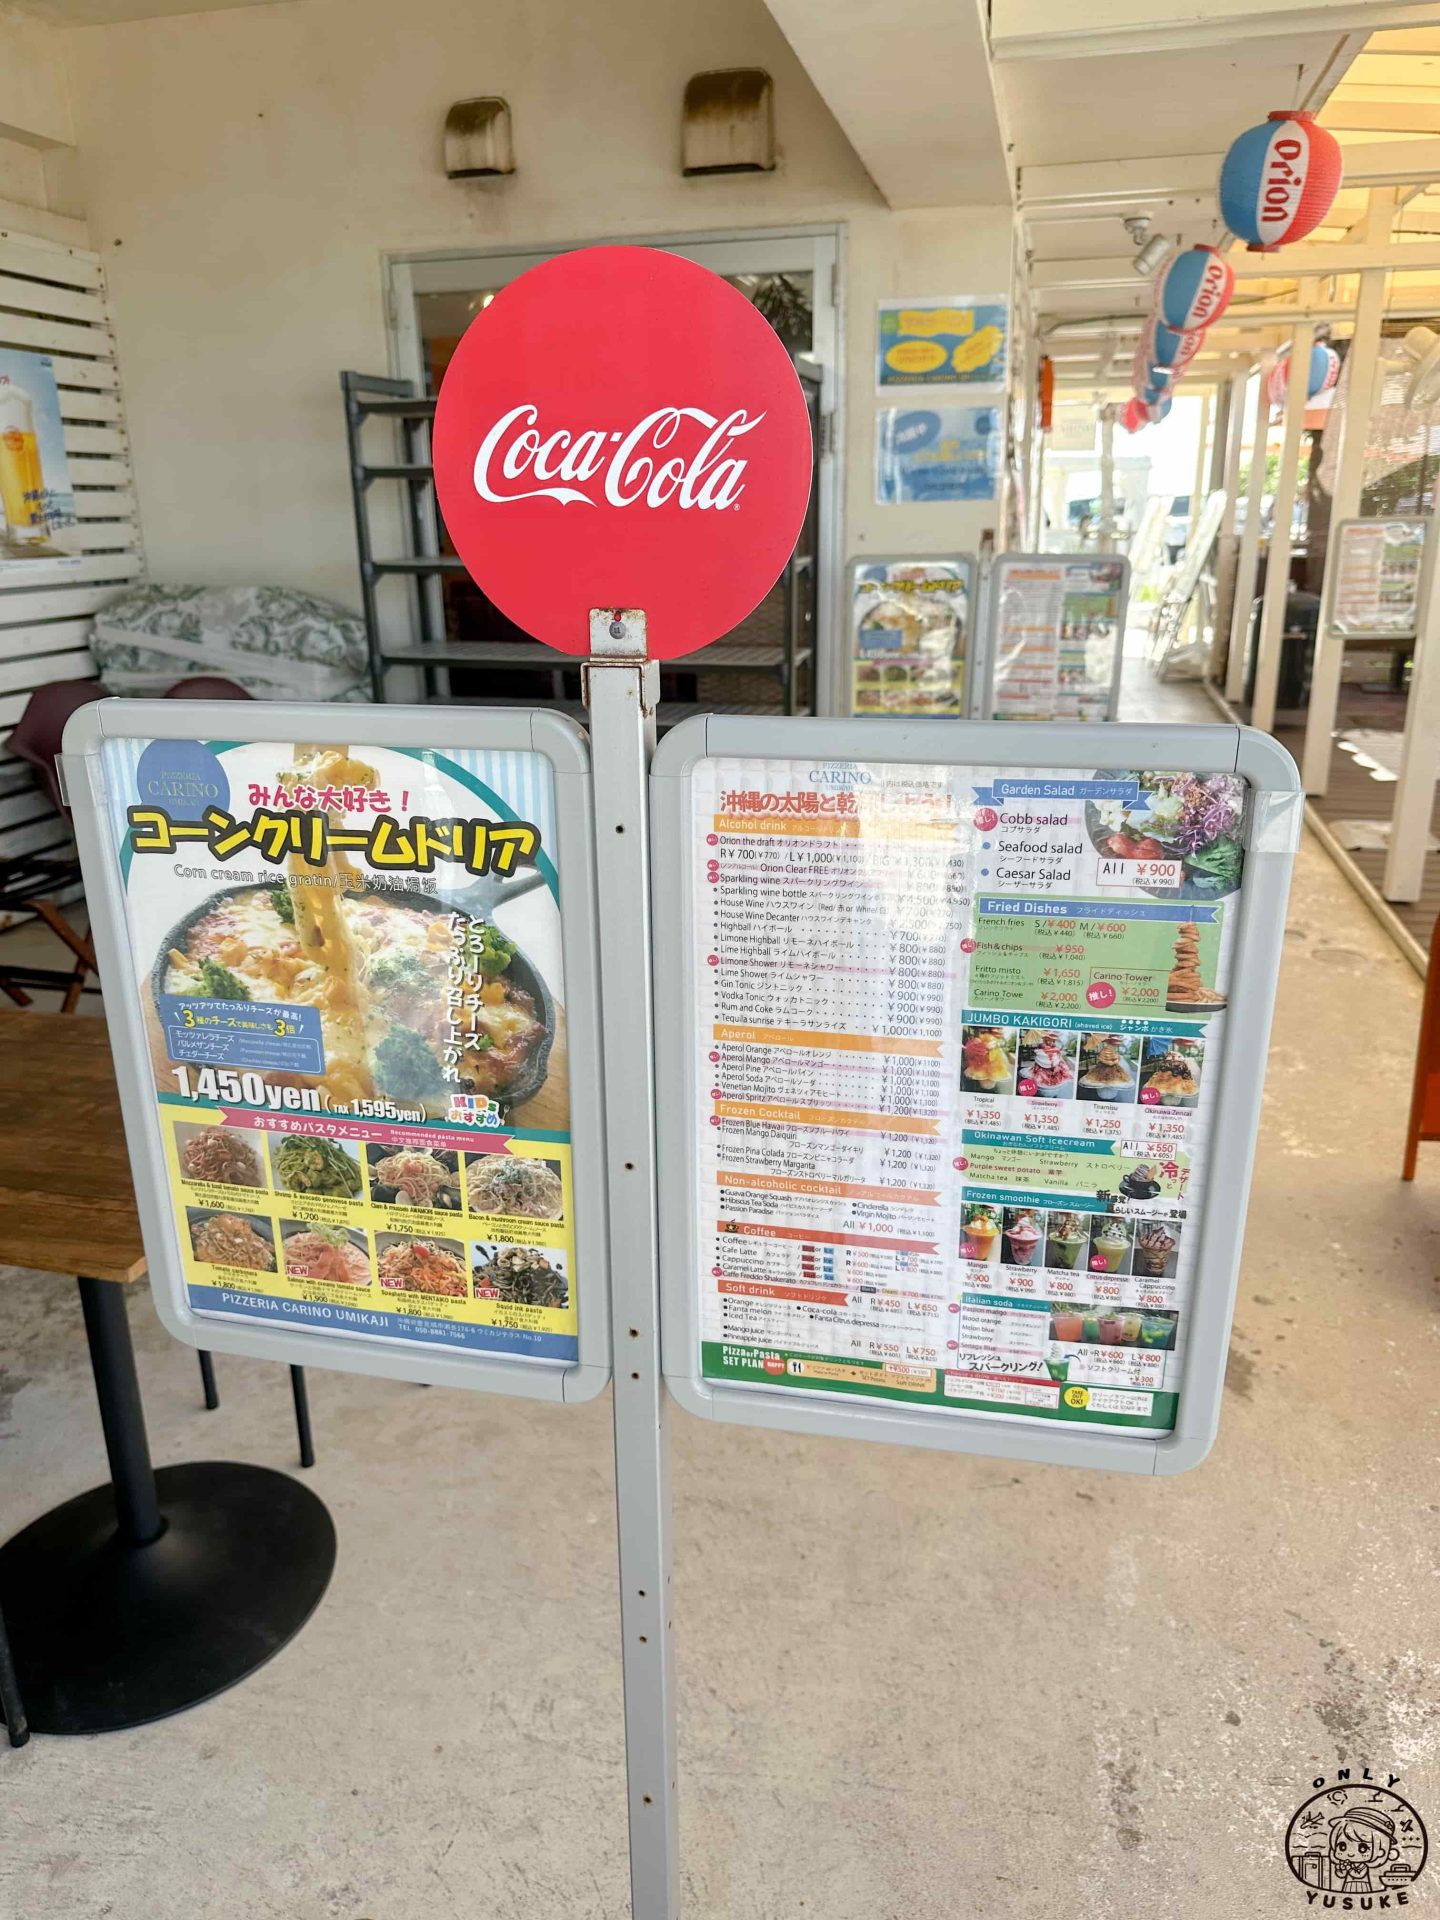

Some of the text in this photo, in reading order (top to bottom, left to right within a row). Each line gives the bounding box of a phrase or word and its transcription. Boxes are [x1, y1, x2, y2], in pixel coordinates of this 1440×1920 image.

[1262, 139, 1302, 222] Orion
[1193, 265, 1223, 319] Orion
[473, 403, 767, 511] Coca-Cola
[809, 770, 871, 784] CARINO
[147, 781, 219, 799] CARINO
[1002, 784, 1133, 796] Garden Salad ガーデンサラダ
[249, 784, 410, 812] みんな大好き！
[720, 819, 787, 831] Alcohol drink
[1000, 813, 1067, 825] Cobb salad
[1002, 826, 1041, 834] コブサラダ
[131, 806, 540, 877] コーンクリームドリア
[720, 836, 839, 849] Orion the draft オリオンドラフト
[999, 840, 1082, 854] Seafood salad
[1000, 856, 1062, 864] シーフードサラダ
[997, 868, 1071, 880] Caesar Salad
[1103, 862, 1124, 874] All
[173, 864, 207, 879] Corn
[209, 868, 253, 882] cream
[257, 870, 284, 885] rice
[720, 874, 758, 886] Sparkling
[760, 877, 780, 885] wine
[999, 881, 1052, 889] シーザーサラダ
[720, 898, 814, 911] House Wine ハウスワイン
[988, 901, 1019, 911] Fried
[1025, 902, 1067, 914] Dishes
[720, 921, 793, 933] Highball ハイボール
[979, 917, 1024, 926] French fries
[720, 934, 748, 943] Limone
[749, 936, 780, 947] Highball
[720, 945, 836, 959] Lime Highball ライムハイボール
[1094, 972, 1152, 982] Carino Tower
[721, 979, 802, 992] Gin Tonic ジントニック
[721, 1002, 813, 1016] Rum and Coke ラムコーク
[721, 1014, 748, 1024] Tequila
[749, 1016, 774, 1024] sunrise
[968, 1013, 1072, 1028] JUMBO KAKIGORI
[721, 1029, 755, 1041] Aperol
[722, 1043, 771, 1054] Aperol Orange
[172, 1066, 320, 1112] 1,450yen
[974, 1096, 994, 1104] Tropical
[450, 1109, 498, 1127] おすすめ
[720, 1104, 801, 1120] Frozen Cocktail
[253, 1116, 382, 1138] おすすめパスタメニュー
[390, 1129, 436, 1139] Recommended
[974, 1131, 1095, 1147] Okinawan Soft icecream
[1123, 1142, 1138, 1150] All
[971, 1153, 1130, 1170] Mango Strawberry ストロベリー
[970, 1163, 1041, 1175] Purple sweet potato
[970, 1172, 992, 1180] Matcha
[724, 1175, 841, 1195] Non-alcoholic cocktail
[967, 1190, 1039, 1204] Frozen smoothie
[469, 1214, 484, 1222] Bacon
[491, 1217, 517, 1225] mushroom
[843, 1221, 855, 1229] All
[744, 1226, 776, 1237] Coffee
[288, 1265, 307, 1275] NEW
[381, 1279, 402, 1288] NEW
[726, 1283, 775, 1296] Soft drink
[476, 1288, 499, 1297] NEW
[965, 1296, 1013, 1308] Italian soda
[222, 1293, 389, 1327] PIZZERIA CARINO UMIKAJI
[802, 1306, 837, 1315] Coca-cola
[723, 1356, 764, 1369] SET PLAN
[959, 1353, 1001, 1362] リフレッシュ
